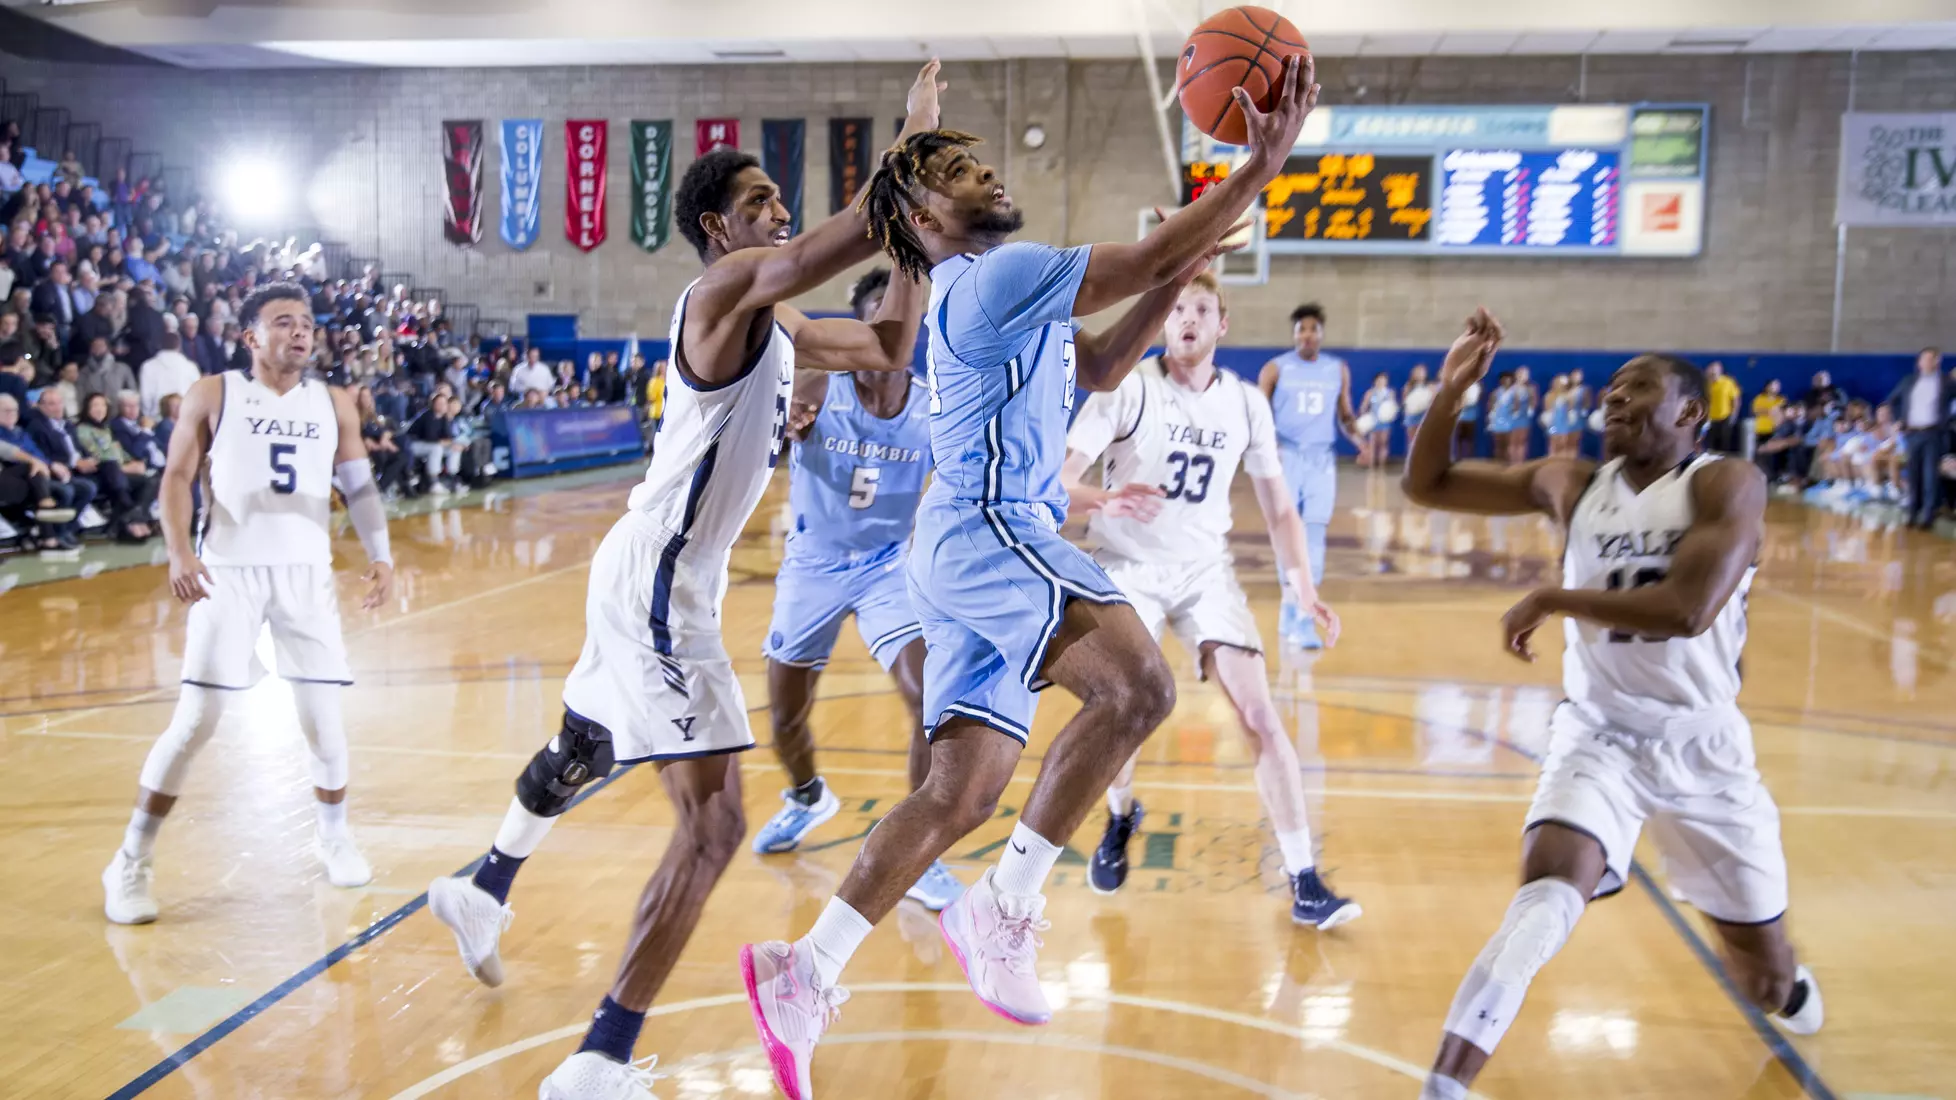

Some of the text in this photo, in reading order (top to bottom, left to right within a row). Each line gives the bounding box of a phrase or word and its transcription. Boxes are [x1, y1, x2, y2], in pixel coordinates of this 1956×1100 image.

[1907, 127, 1945, 142] THE
[514, 125, 530, 245] COLUMBIA
[578, 125, 595, 247] CORNELL
[643, 125, 660, 249] DARTMOUTH
[1297, 391, 1324, 416] 13
[244, 416, 320, 440] YALE
[1165, 422, 1227, 450] YALE
[823, 436, 921, 463] COLUMBIA
[269, 442, 298, 496] 5
[1158, 450, 1216, 504] 33
[847, 465, 882, 511] 5
[670, 716, 697, 742] Y
